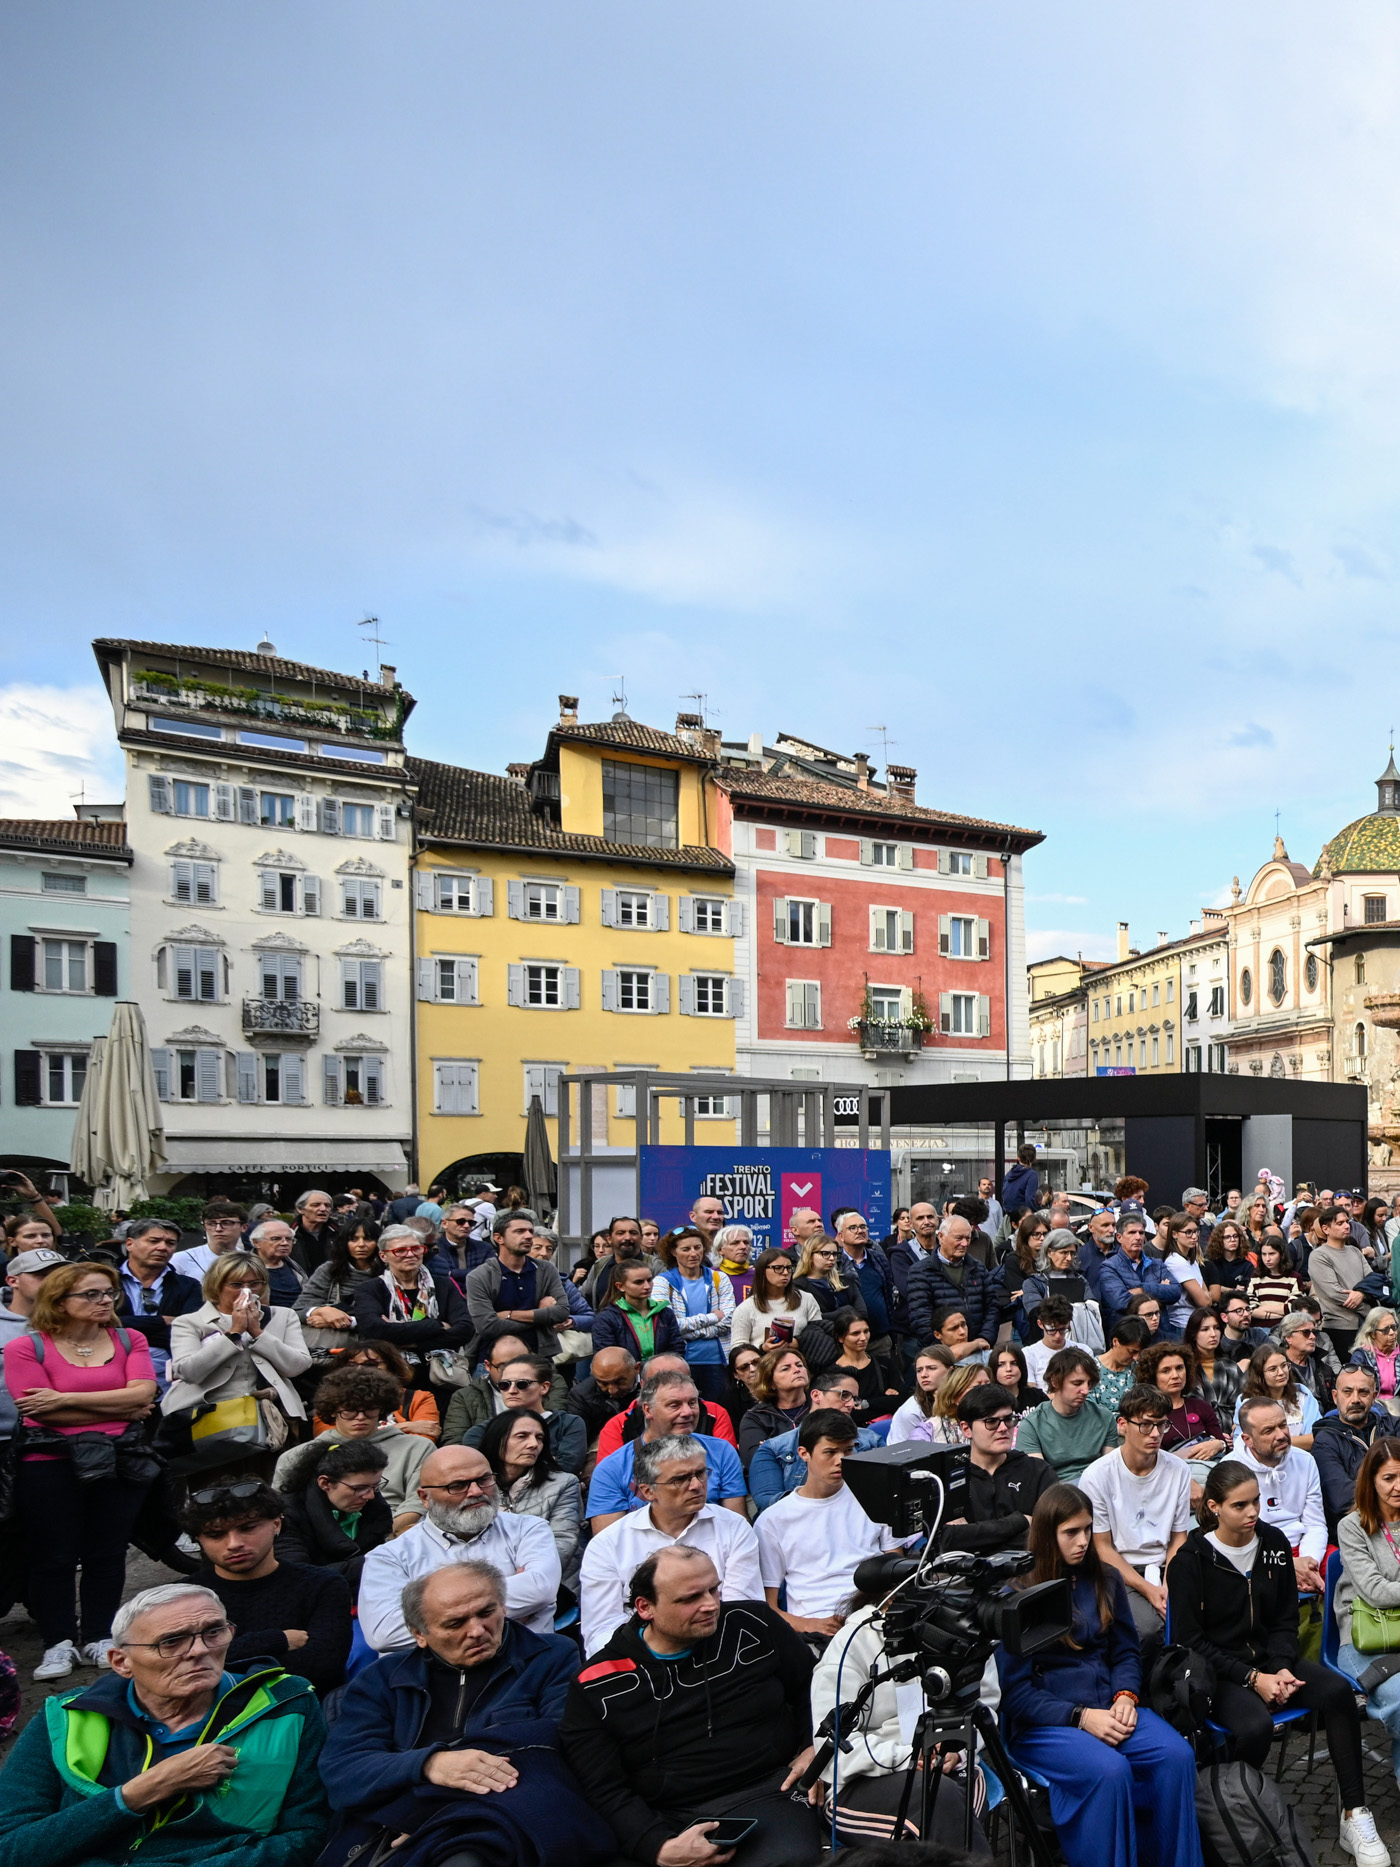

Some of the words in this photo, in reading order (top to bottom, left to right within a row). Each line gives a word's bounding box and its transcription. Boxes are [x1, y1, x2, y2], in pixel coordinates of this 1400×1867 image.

[733, 1165, 772, 1174] TRENTO
[706, 1173, 776, 1196] FESTIVAL
[723, 1195, 776, 1219] SPORT
